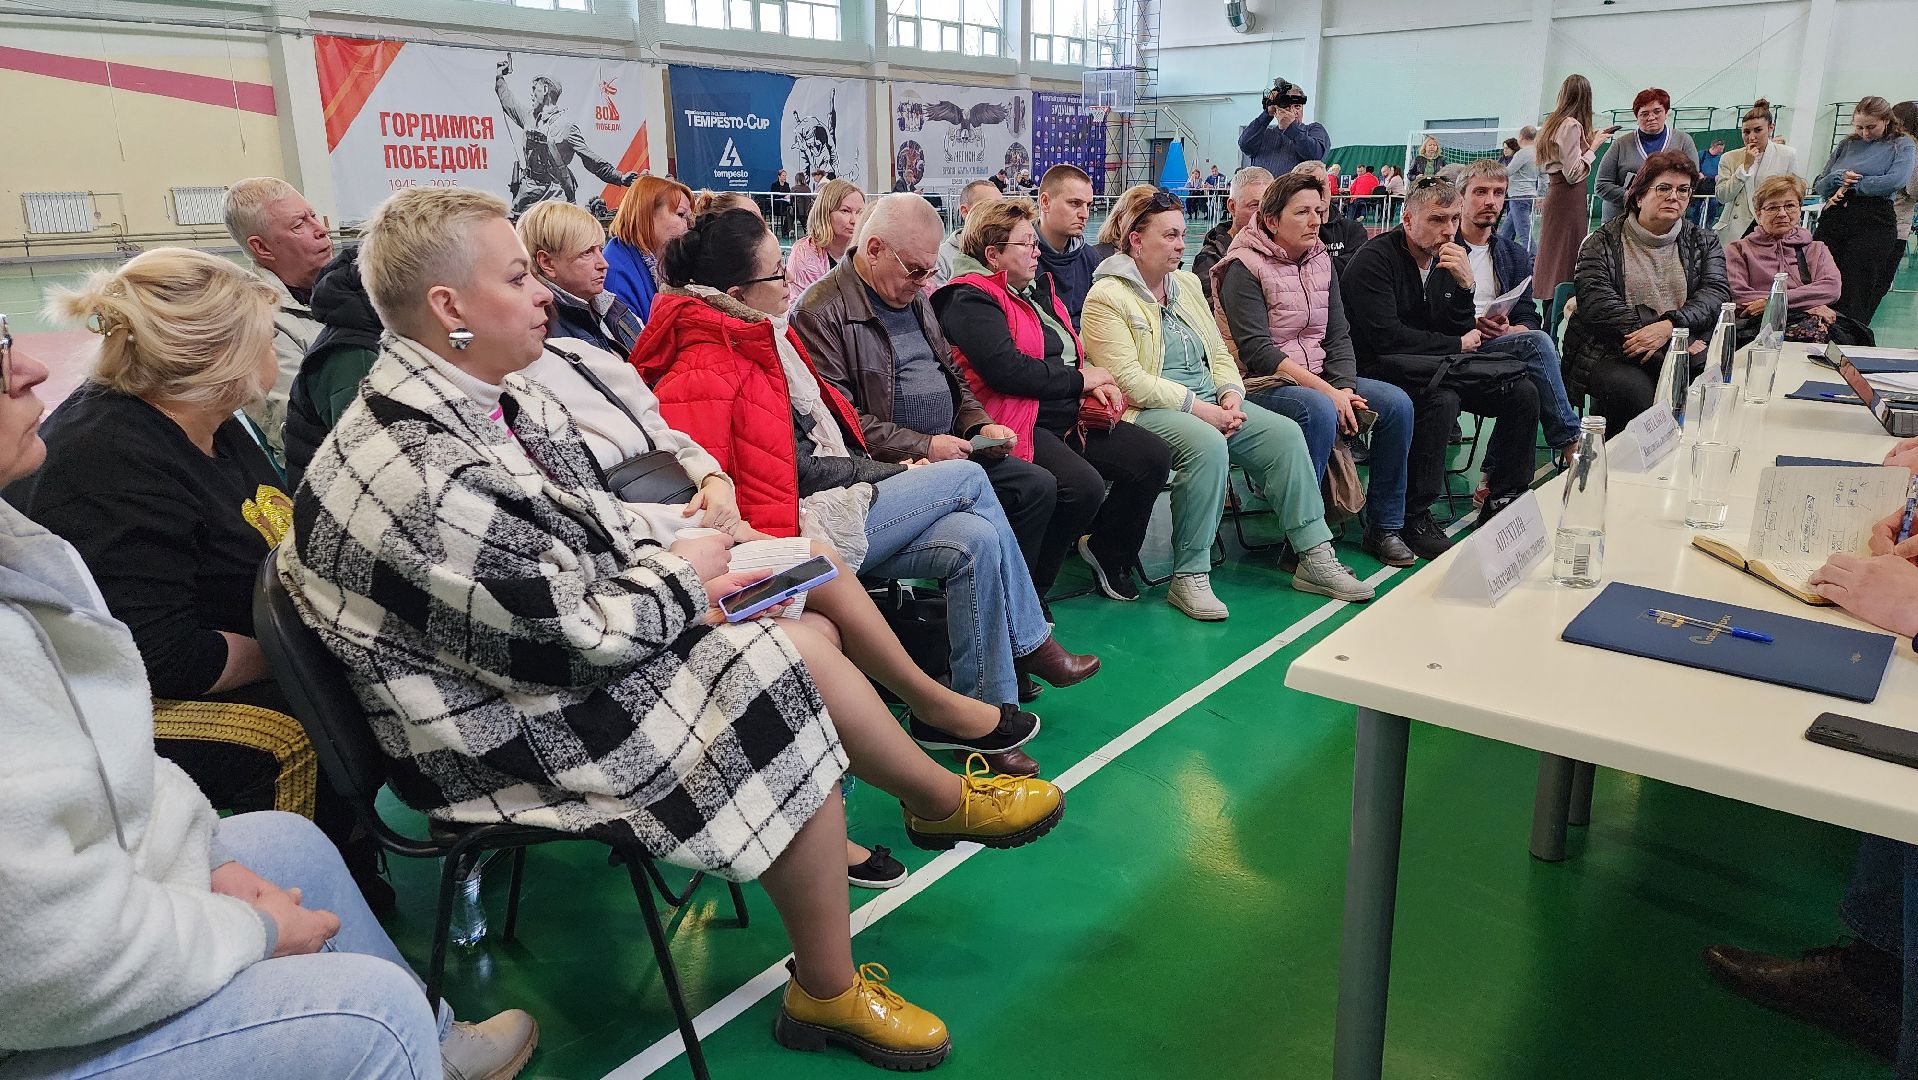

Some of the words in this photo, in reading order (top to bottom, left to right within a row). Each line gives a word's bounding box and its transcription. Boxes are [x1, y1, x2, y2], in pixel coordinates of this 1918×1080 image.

[595, 105, 609, 121] 80
[379, 111, 495, 140] ГОРДИМСЯ
[383, 143, 488, 173] ПОБЕДОЙ!
[714, 170, 748, 179] tempesto
[388, 179, 417, 191] 1945
